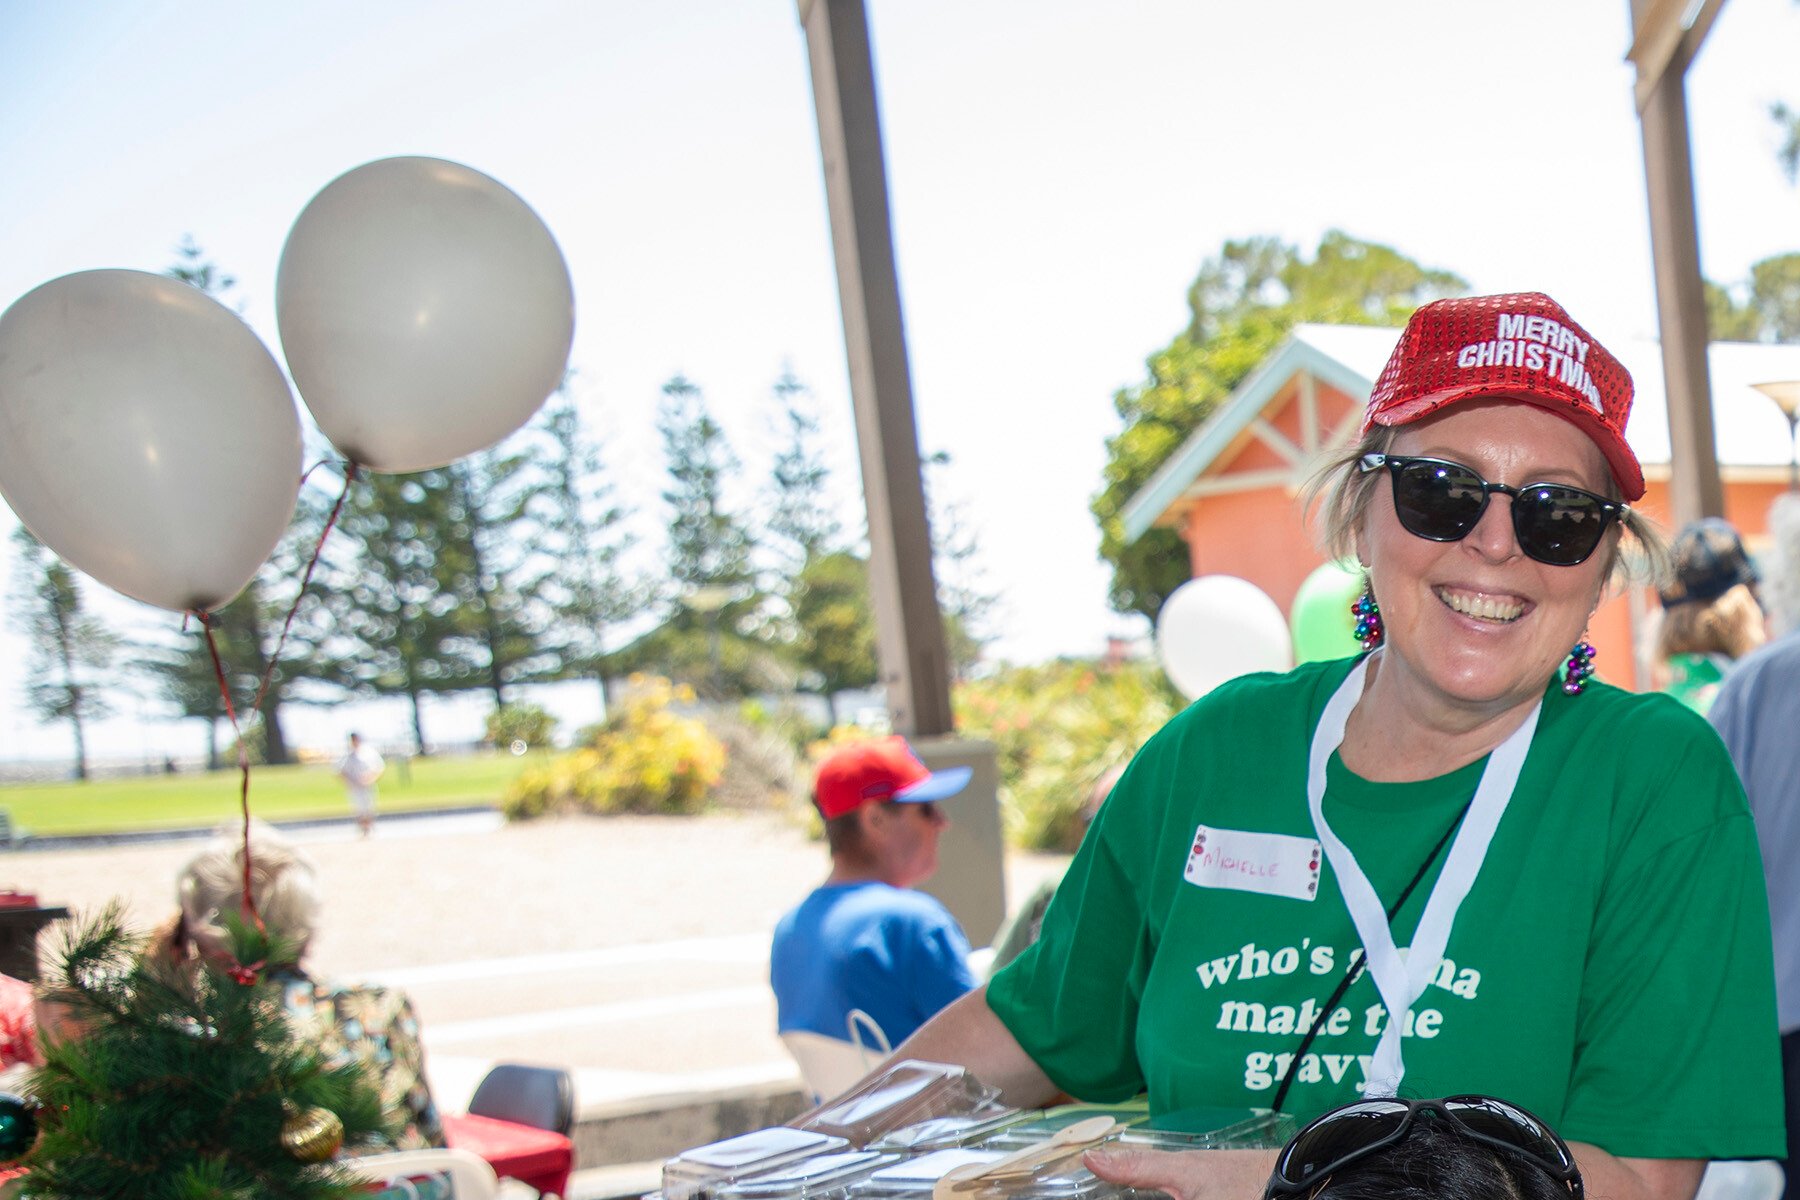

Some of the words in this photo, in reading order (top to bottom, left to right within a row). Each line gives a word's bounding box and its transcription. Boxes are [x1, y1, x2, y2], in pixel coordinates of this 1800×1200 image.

[1497, 313, 1590, 365] MERRY
[1457, 340, 1604, 415] CHRISTMA
[1196, 937, 1335, 990] who's
[1216, 998, 1351, 1036] make
